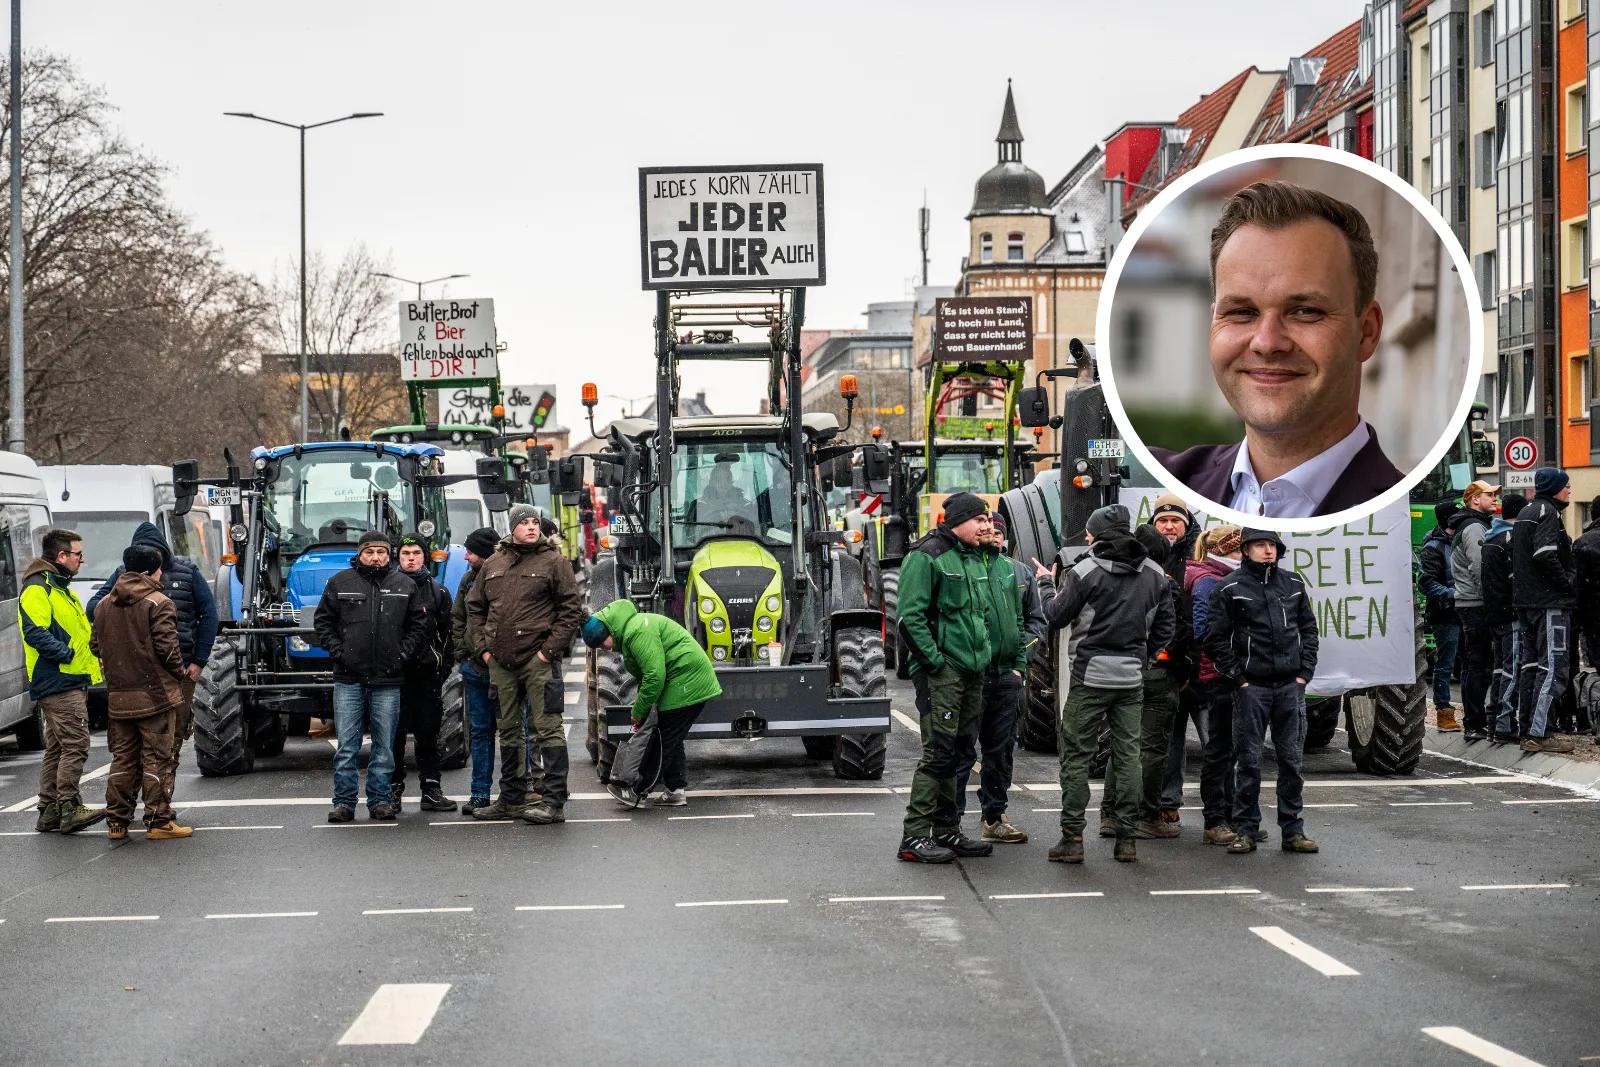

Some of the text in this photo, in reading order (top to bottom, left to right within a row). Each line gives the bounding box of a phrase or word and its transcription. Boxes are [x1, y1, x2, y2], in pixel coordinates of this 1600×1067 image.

[653, 172, 812, 199] JEDES KORN ZÄHLT
[678, 201, 787, 232] JEDER
[650, 237, 814, 279] BAUER AUCH
[944, 307, 957, 316] Es
[973, 306, 994, 315] kein
[996, 306, 1024, 315] Stand
[944, 320, 956, 328] so
[958, 319, 982, 328] hoch
[984, 319, 996, 327] im
[417, 321, 466, 341] & Bier
[944, 332, 966, 340] dass
[981, 331, 1005, 339] nicht
[1007, 330, 1026, 338] lebt
[947, 344, 964, 352] von
[430, 356, 464, 378] DIR
[508, 387, 532, 406] die
[1094, 441, 1111, 449] GTH
[1092, 449, 1121, 457] BZ 114
[1512, 446, 1530, 460] 30
[214, 489, 231, 497] MGN
[210, 496, 232, 506] SK 99
[1284, 545, 1384, 588] REIE
